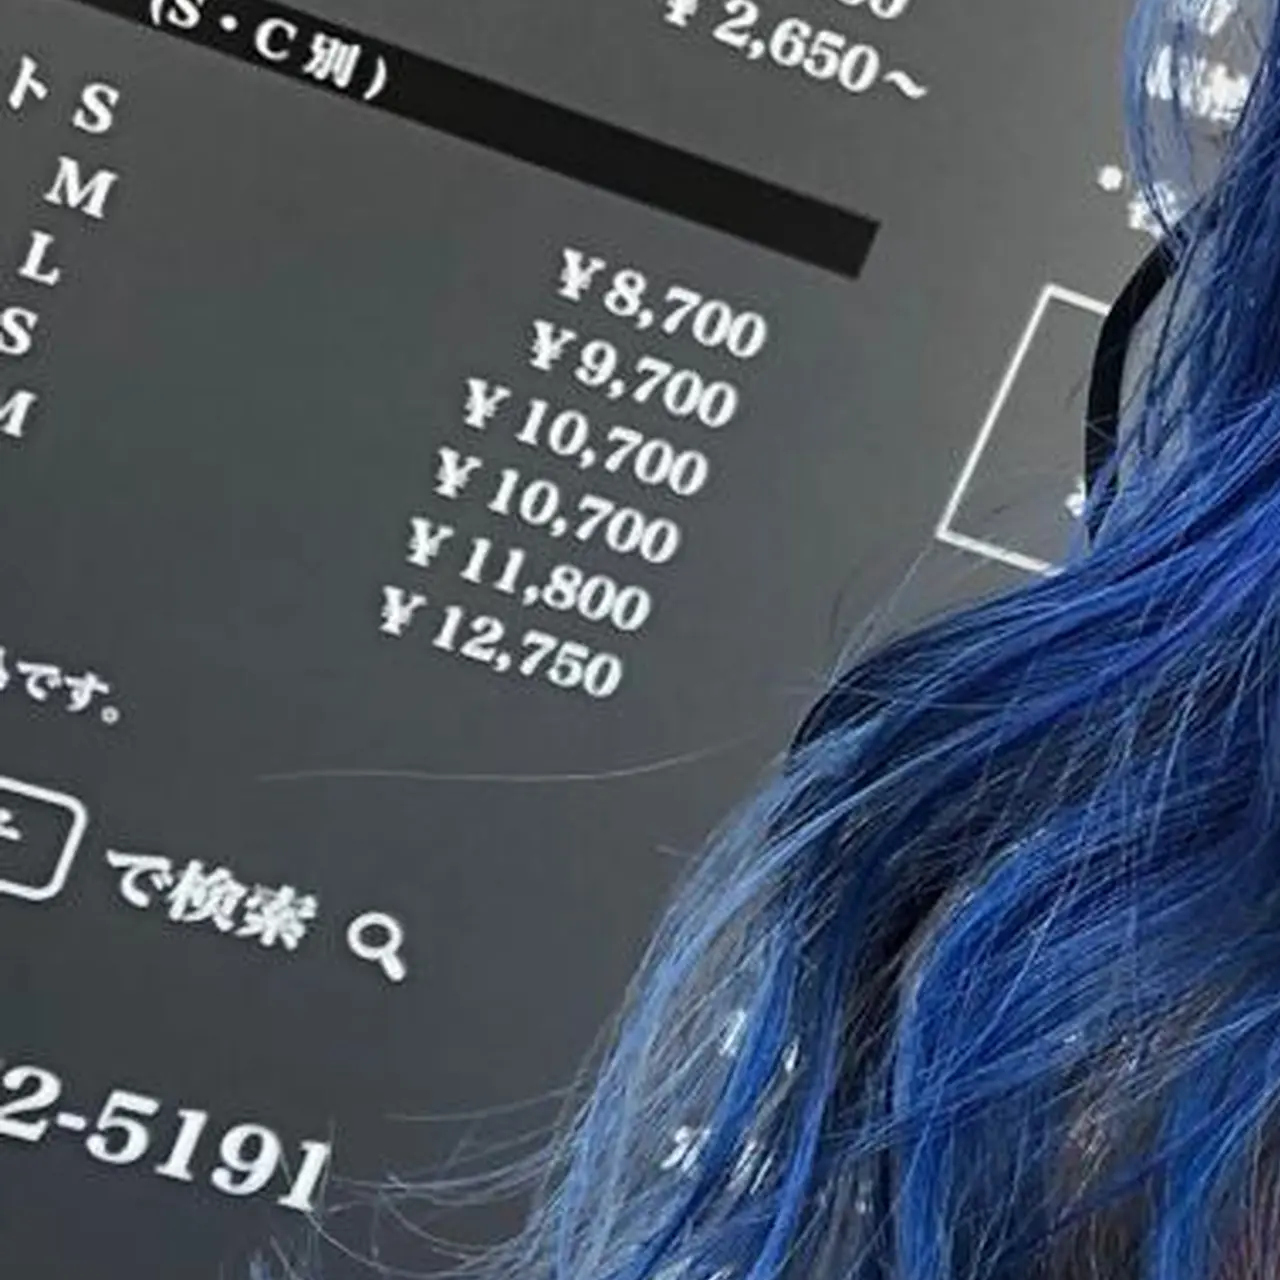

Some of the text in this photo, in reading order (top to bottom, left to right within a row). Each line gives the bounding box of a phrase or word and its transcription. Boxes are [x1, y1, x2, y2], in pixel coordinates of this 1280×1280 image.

[72, 82, 120, 134] S
[43, 156, 119, 219] M
[18, 230, 61, 286] L
[558, 247, 768, 359] ¥8,700
[0, 306, 39, 356] S
[529, 319, 739, 428] ¥9,700
[464, 377, 709, 496] ¥10,700
[434, 446, 680, 564] ¥10,700
[407, 516, 651, 631] ¥11,800
[0, 645, 120, 725] です。
[380, 585, 623, 698] ¥12,750
[105, 849, 319, 951] で検索
[0, 1065, 332, 1213] 2-5191
